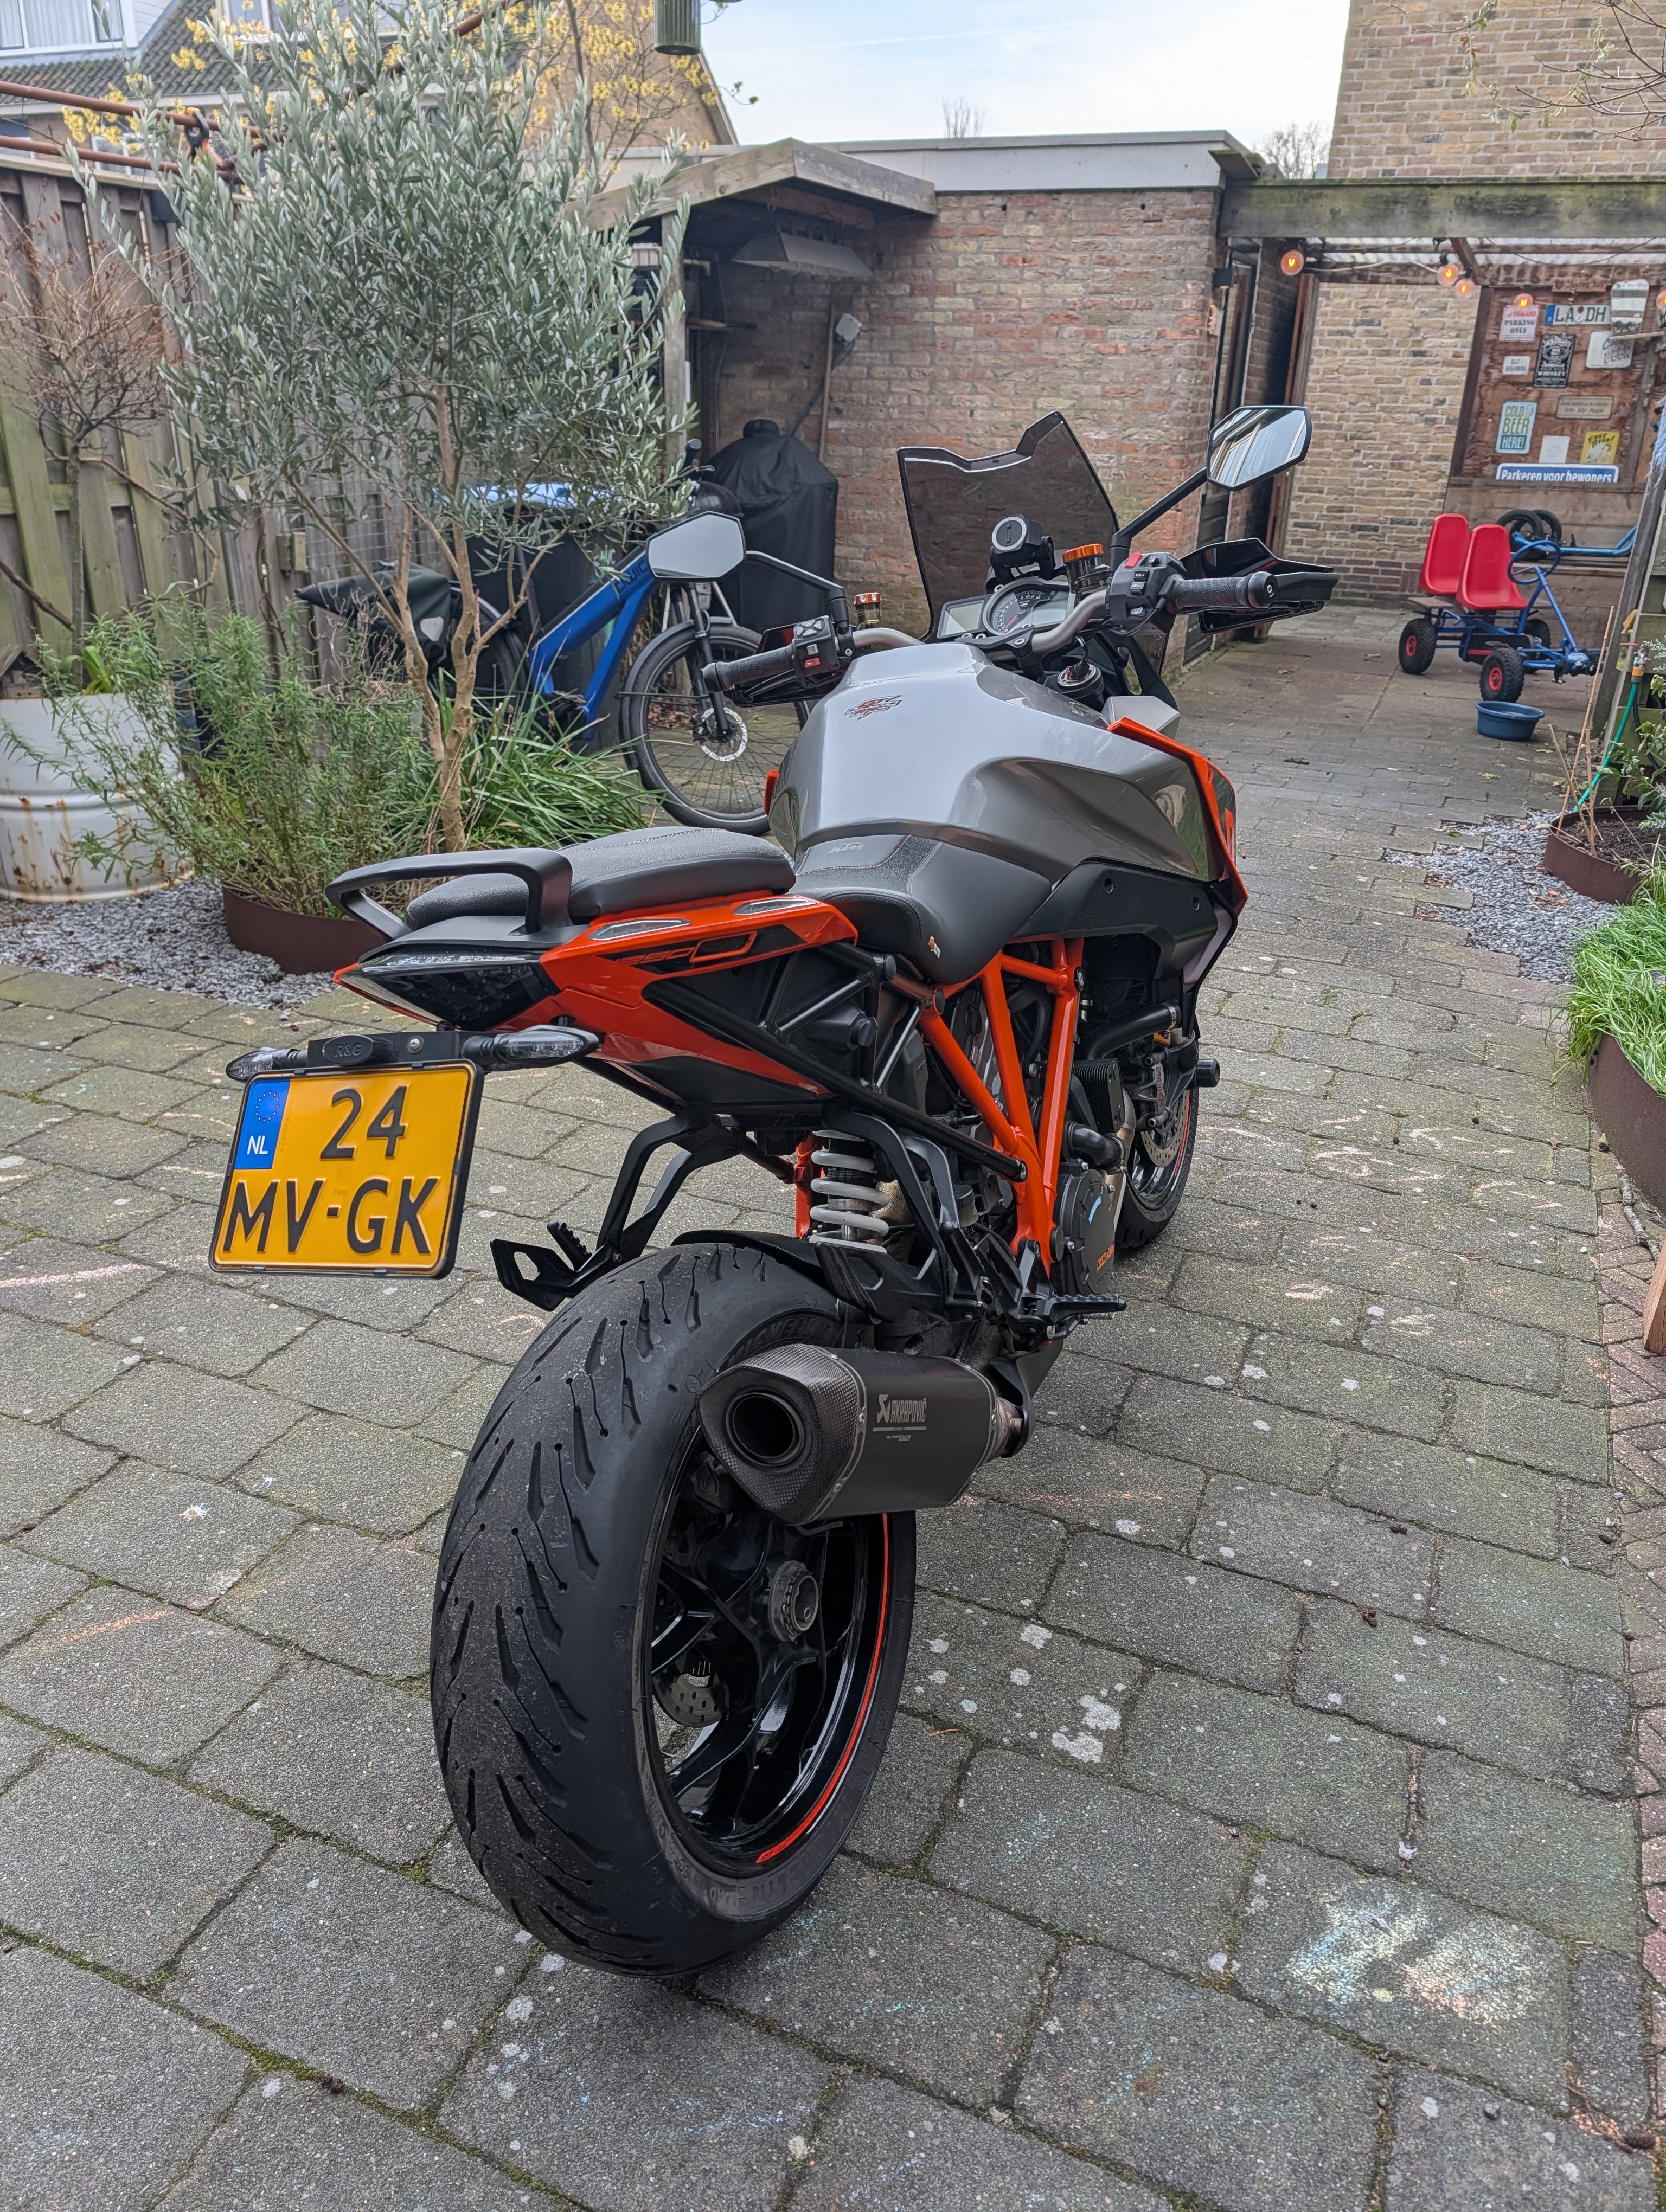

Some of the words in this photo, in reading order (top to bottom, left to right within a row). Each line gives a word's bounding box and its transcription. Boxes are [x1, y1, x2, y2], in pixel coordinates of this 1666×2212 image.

[1585, 307, 1607, 322] DH
[1505, 406, 1524, 417] COLD
[1503, 417, 1529, 434] BEER
[1501, 436, 1524, 449] HERE!
[1501, 469, 1542, 481] Parkeren
[1543, 471, 1565, 481] voor
[1566, 470, 1612, 483] bewoners
[334, 1042, 362, 1057] R&G
[320, 1086, 409, 1160] 24
[247, 1135, 268, 1155] NL
[223, 1178, 438, 1254] MV-GK
